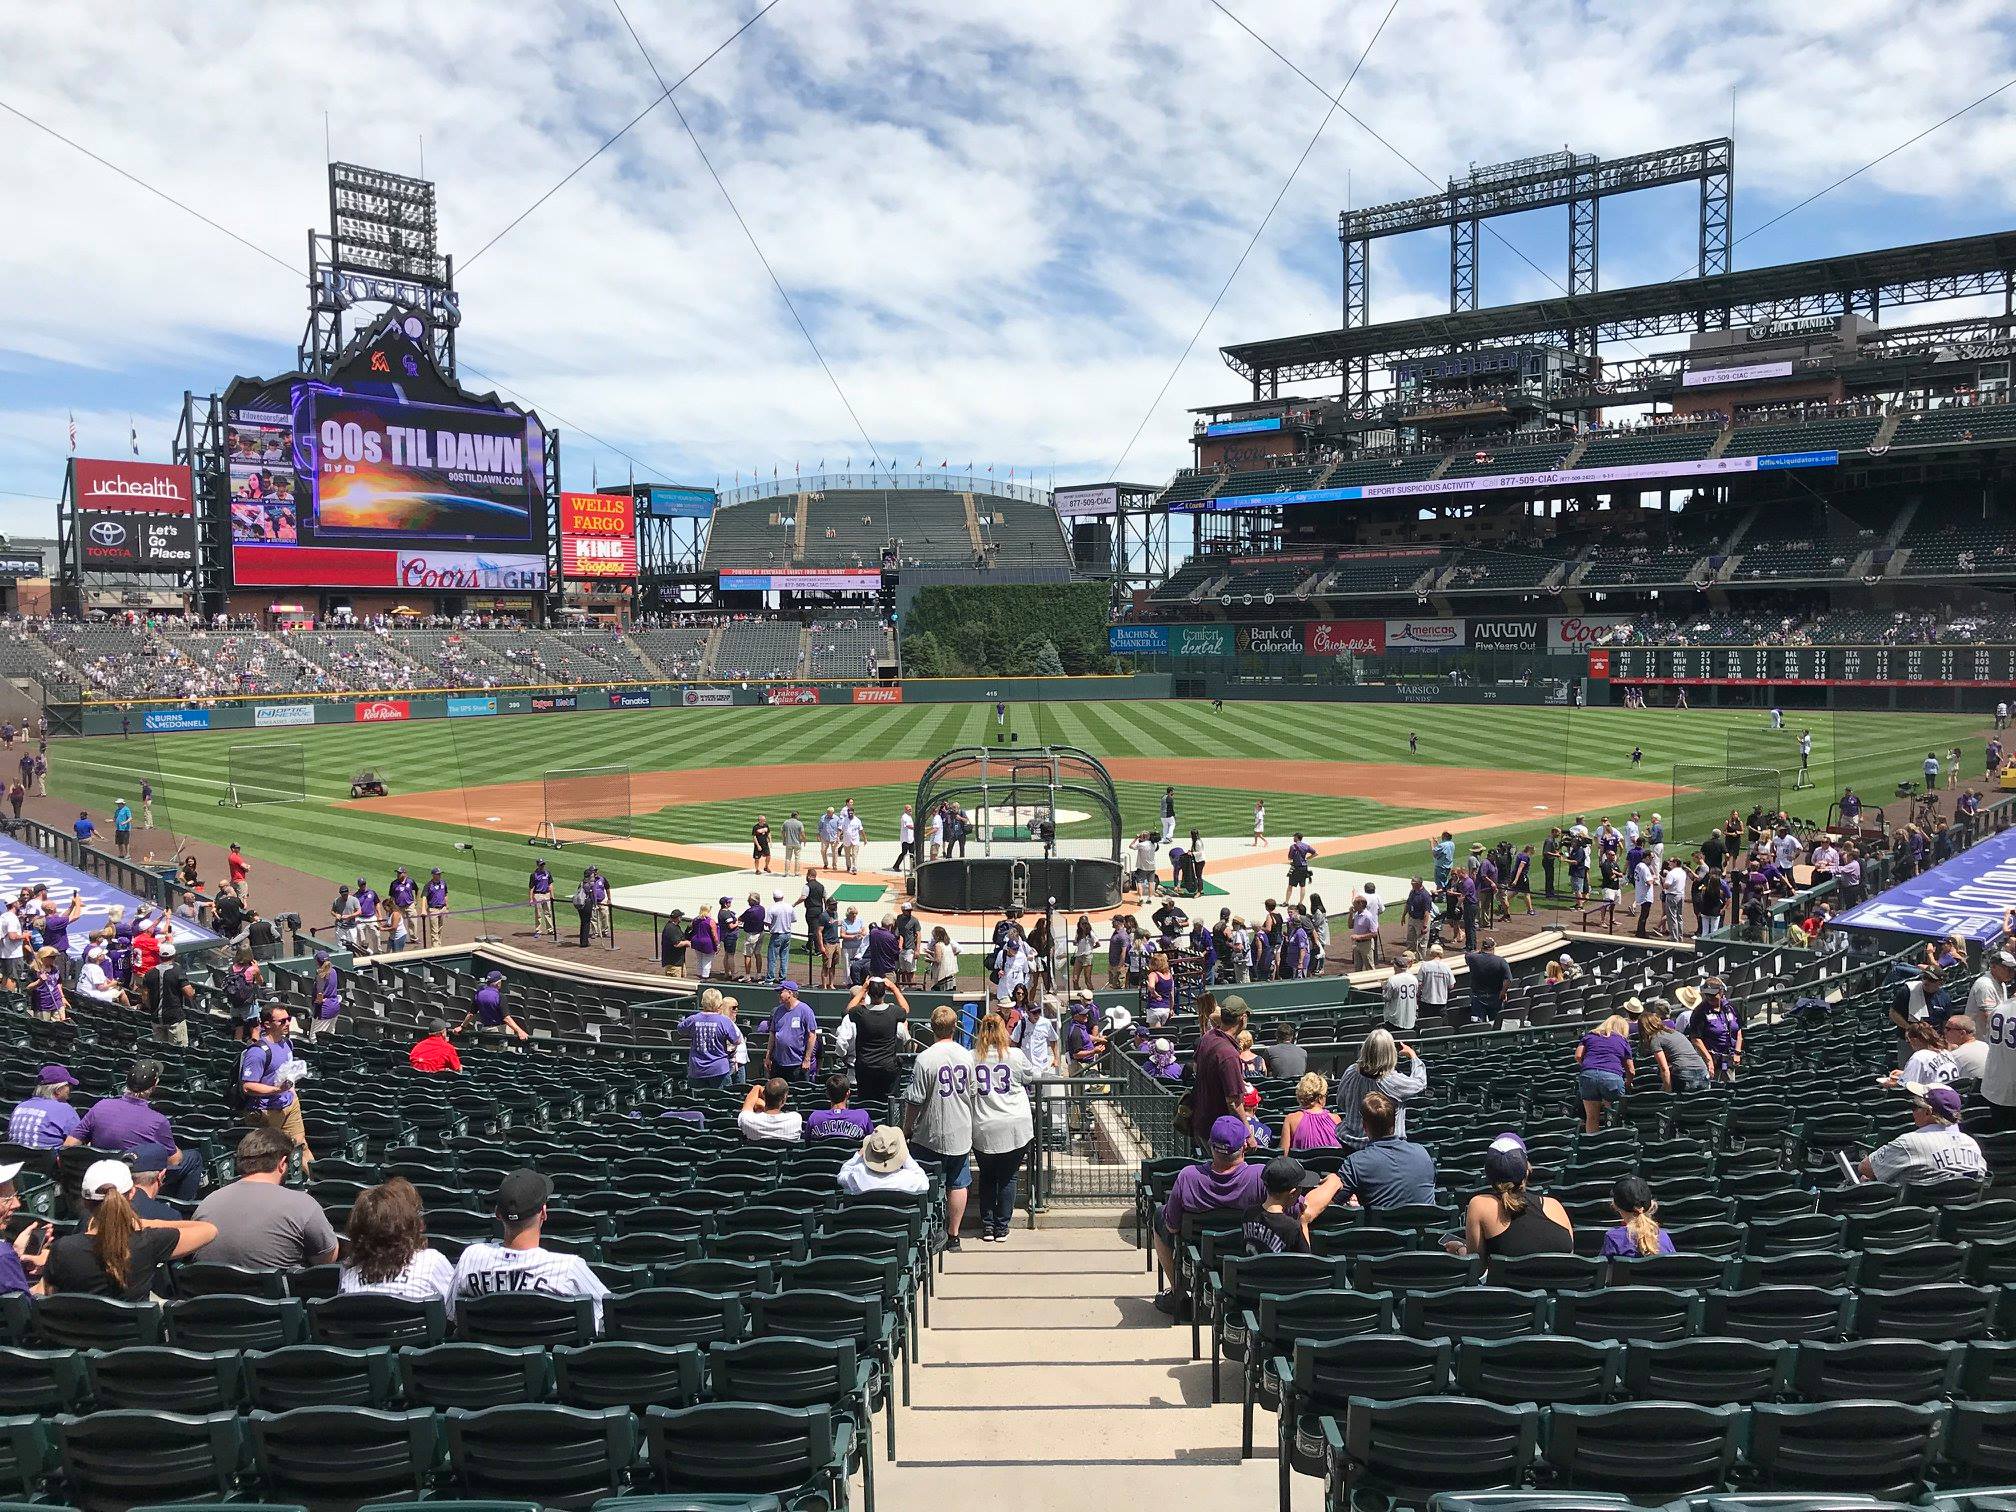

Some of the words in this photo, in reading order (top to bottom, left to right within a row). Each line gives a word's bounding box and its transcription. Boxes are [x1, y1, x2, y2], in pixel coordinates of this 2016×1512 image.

[1769, 320, 1795, 334] JACK
[1961, 344, 2010, 360] Silver
[321, 420, 383, 463] 90s
[386, 425, 432, 469] TIL
[437, 430, 523, 475] DAWN
[1759, 455, 1837, 467] OfficeLiquidators.com
[93, 474, 178, 498] uchealth
[448, 472, 524, 487] 90STILDAWN.COM
[1368, 486, 1396, 496] REPORT
[1397, 483, 1441, 494] SUSPICIOUS
[1442, 480, 1476, 491] ACTIVITY
[1500, 474, 1558, 487] 877-509-CIAC
[571, 497, 624, 514] WELLS
[149, 524, 178, 536] Let's
[573, 515, 625, 531] FARGO
[149, 536, 167, 547] Go
[576, 539, 623, 557] KING
[87, 547, 133, 558] TOYOTA
[150, 548, 191, 559] Places
[402, 557, 480, 590] Coors
[484, 569, 547, 591] LIGHT
[1117, 629, 1149, 639] BACHUS
[1150, 629, 1159, 639] &
[1182, 627, 1219, 640] Comfort
[1251, 627, 1278, 640] Bank
[1281, 626, 1294, 639] of
[1475, 622, 1537, 638] ARROW
[1560, 618, 1613, 643] Coo
[1110, 637, 1151, 648] SCHANKER
[1152, 639, 1167, 648] LLC
[1181, 637, 1223, 655] dental
[1251, 640, 1304, 653] Colorado
[1475, 641, 1493, 651] Five
[1493, 641, 1518, 651] Years
[1519, 641, 1537, 651] Out
[857, 691, 898, 701] STIHL
[1397, 685, 1440, 695] MARSICO
[621, 697, 650, 706] Fanatics
[155, 714, 183, 722] BURNS
[363, 708, 379, 720] Red
[379, 708, 402, 719] Robin
[1400, 983, 1416, 999] 93
[1989, 1013, 2016, 1049] 93
[938, 1064, 968, 1098] 93
[974, 1063, 1011, 1096] 93
